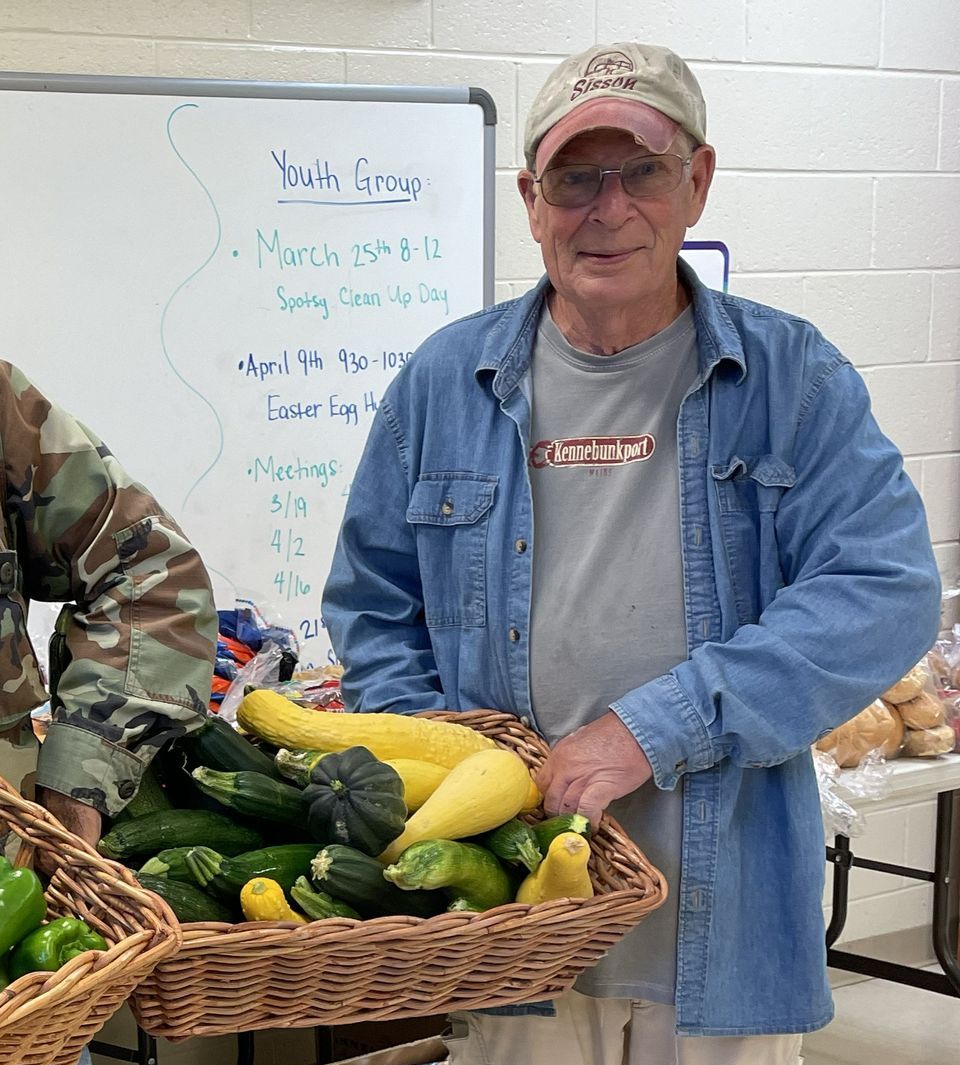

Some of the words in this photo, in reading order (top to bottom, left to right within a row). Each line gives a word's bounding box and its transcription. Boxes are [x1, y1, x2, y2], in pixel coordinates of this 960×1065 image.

[570, 76, 638, 102] Sisson
[271, 150, 341, 193] Youth
[256, 228, 340, 270] March
[352, 238, 391, 268] 25th
[400, 235, 442, 262] 8-12
[276, 286, 329, 320] Spotsy
[339, 285, 382, 308] Clean
[386, 286, 412, 310] Up
[418, 283, 450, 315] Day
[246, 350, 290, 381] April
[297, 349, 324, 376] 9th
[267, 394, 322, 421] Easter
[329, 394, 359, 426] Egg
[553, 437, 648, 463] Kennebunkport
[270, 490, 308, 518] 3/19
[270, 528, 305, 562] 4/2
[273, 571, 311, 601] 4/16
